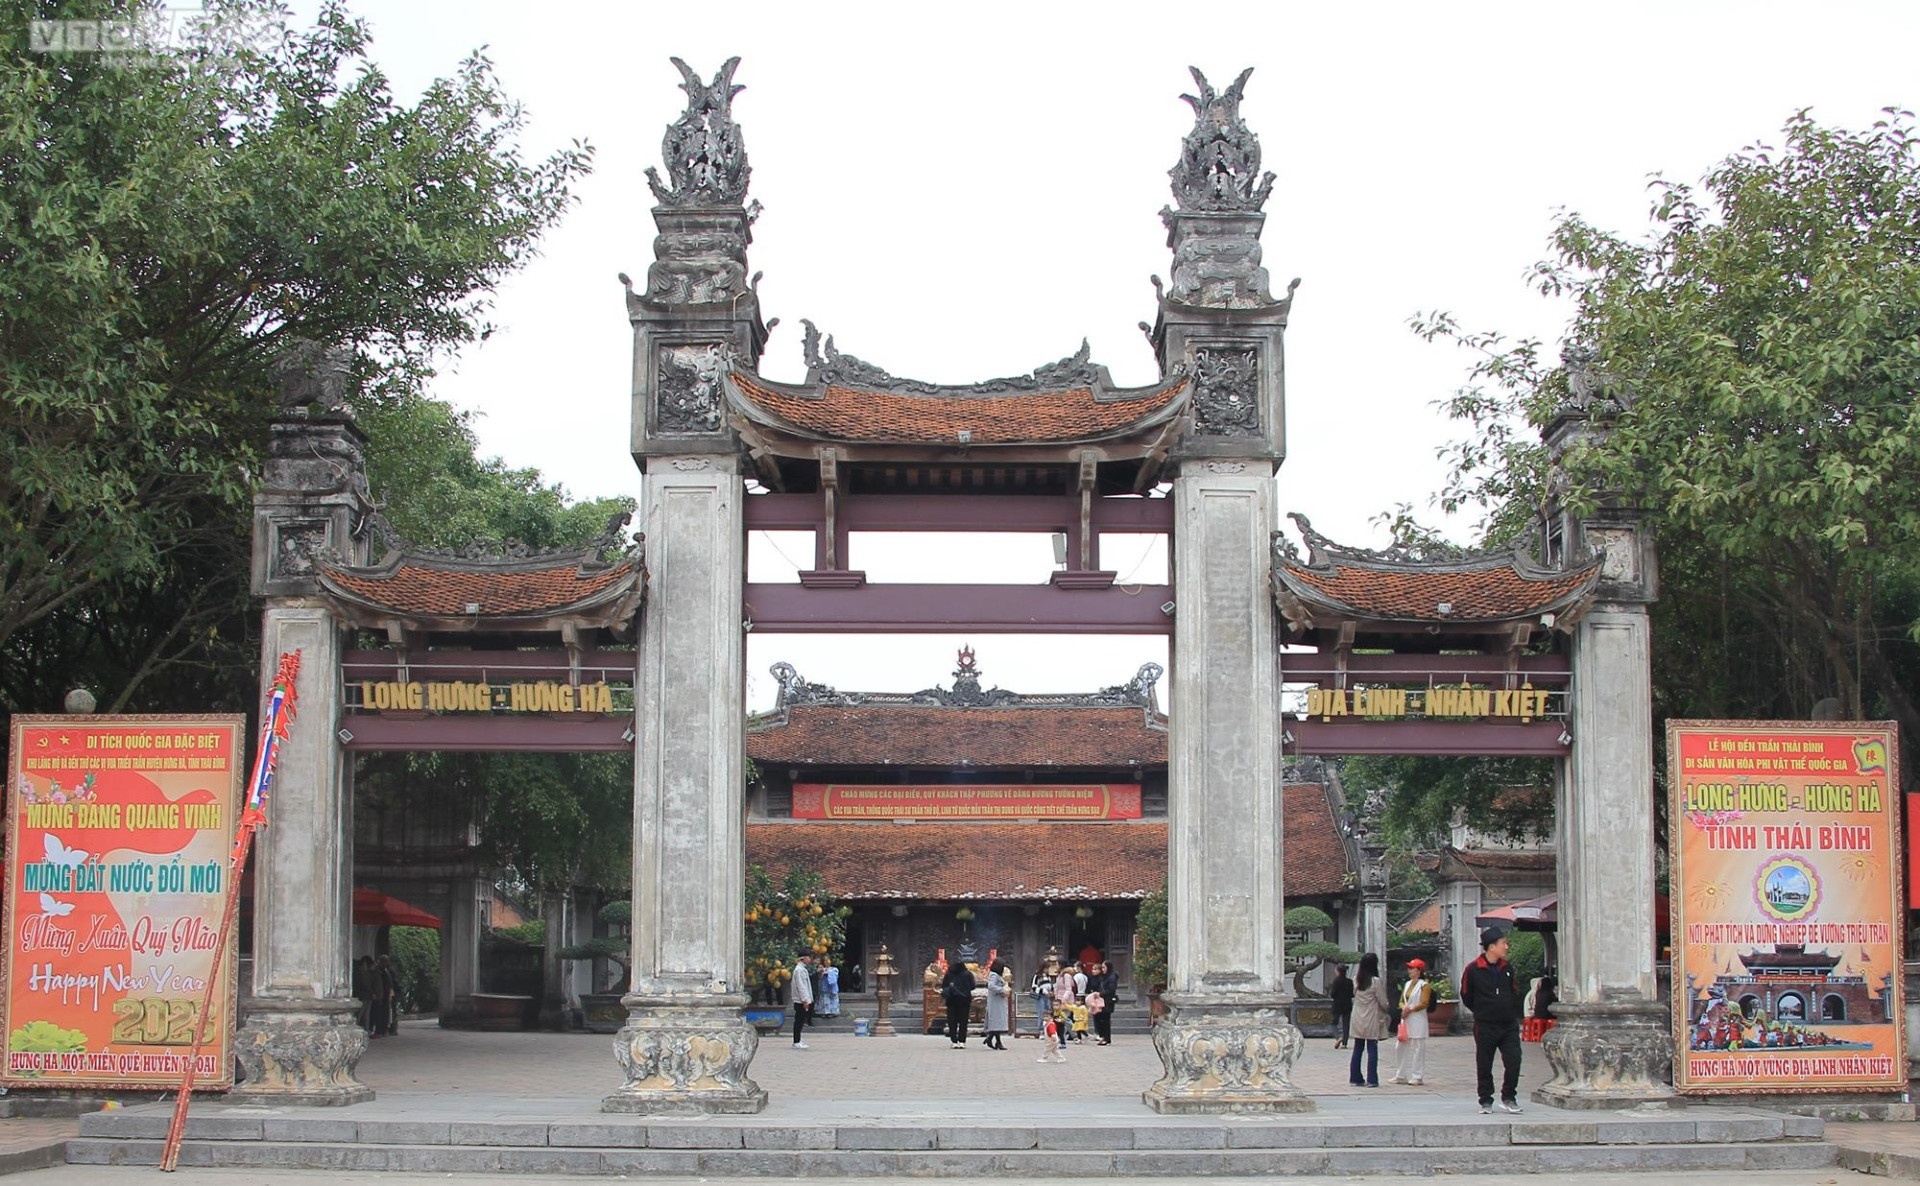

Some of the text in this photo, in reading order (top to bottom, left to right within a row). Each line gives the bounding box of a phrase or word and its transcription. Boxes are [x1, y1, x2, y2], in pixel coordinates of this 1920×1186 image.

[362, 682, 422, 709] LONG
[428, 681, 491, 711] HƯNG
[511, 681, 574, 713] HƯNG
[580, 680, 613, 713] HÀ
[1307, 689, 1348, 722] ĐỊA
[1353, 689, 1406, 715] LINH
[1425, 682, 1490, 716] NHÂN
[1495, 682, 1549, 723] KIỆT
[87, 730, 220, 751] DI TÍCH QUỐC GIA ĐẶC BIỆT
[1709, 738, 1824, 754] LỄ HỘI ĐỀN TRẦN THÁI BÌNH
[1686, 755, 1848, 771] DI SẢN VĂN HÓA PHI VẬT THẾ QUỐC GIA
[26, 793, 221, 831] MỪNG ĐẢNG QUANG VINH
[1686, 783, 1734, 811] LONG
[1739, 782, 1788, 812] HƯNG
[1804, 782, 1853, 812] HƯNG
[1857, 781, 1881, 813] HÀ
[1706, 818, 1870, 850] TỈNH THÁI BÌNH
[24, 854, 221, 893] MỪNG ĐẤT NƯỚC ĐỔI MỚI
[22, 914, 218, 956] Mừng Xuân Quý Mão
[1689, 918, 1888, 948] NƠI PHÁT TÍCH VÀ DỰNG NGHIỆP ĐẾ VƯƠNG TRIỀU TRẦN
[30, 963, 206, 1011] Happy New Year
[11, 1047, 215, 1076] HƯNG HÀ MỘT MIỀN QUÊ HUYỀN TOẠI
[1691, 1055, 1892, 1079] HƯNG HÀ MỘT VÙNG ĐỊA LINH NHÂN KIỆT
